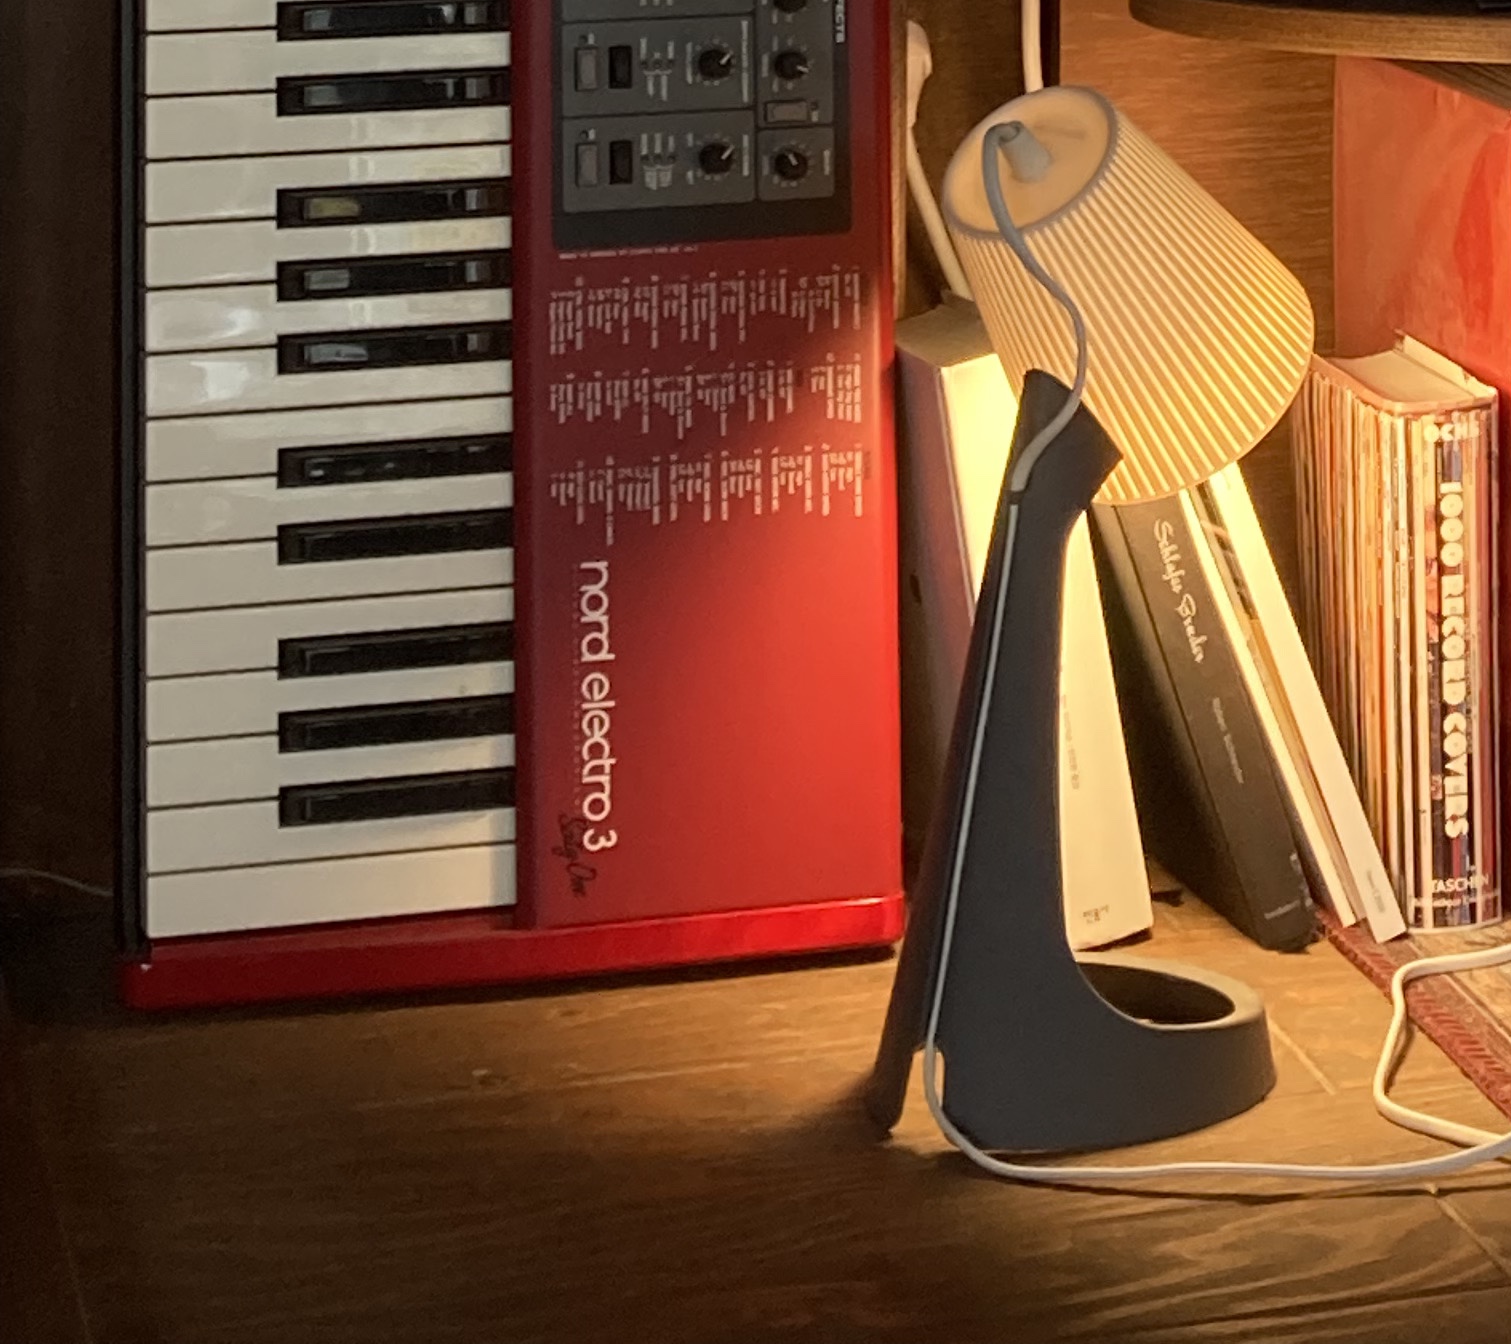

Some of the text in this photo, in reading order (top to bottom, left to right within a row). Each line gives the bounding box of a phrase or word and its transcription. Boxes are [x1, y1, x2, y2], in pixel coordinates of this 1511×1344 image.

[579, 560, 618, 853] nord electro 3
[1439, 481, 1469, 839] 1000 RECORD COVERS
